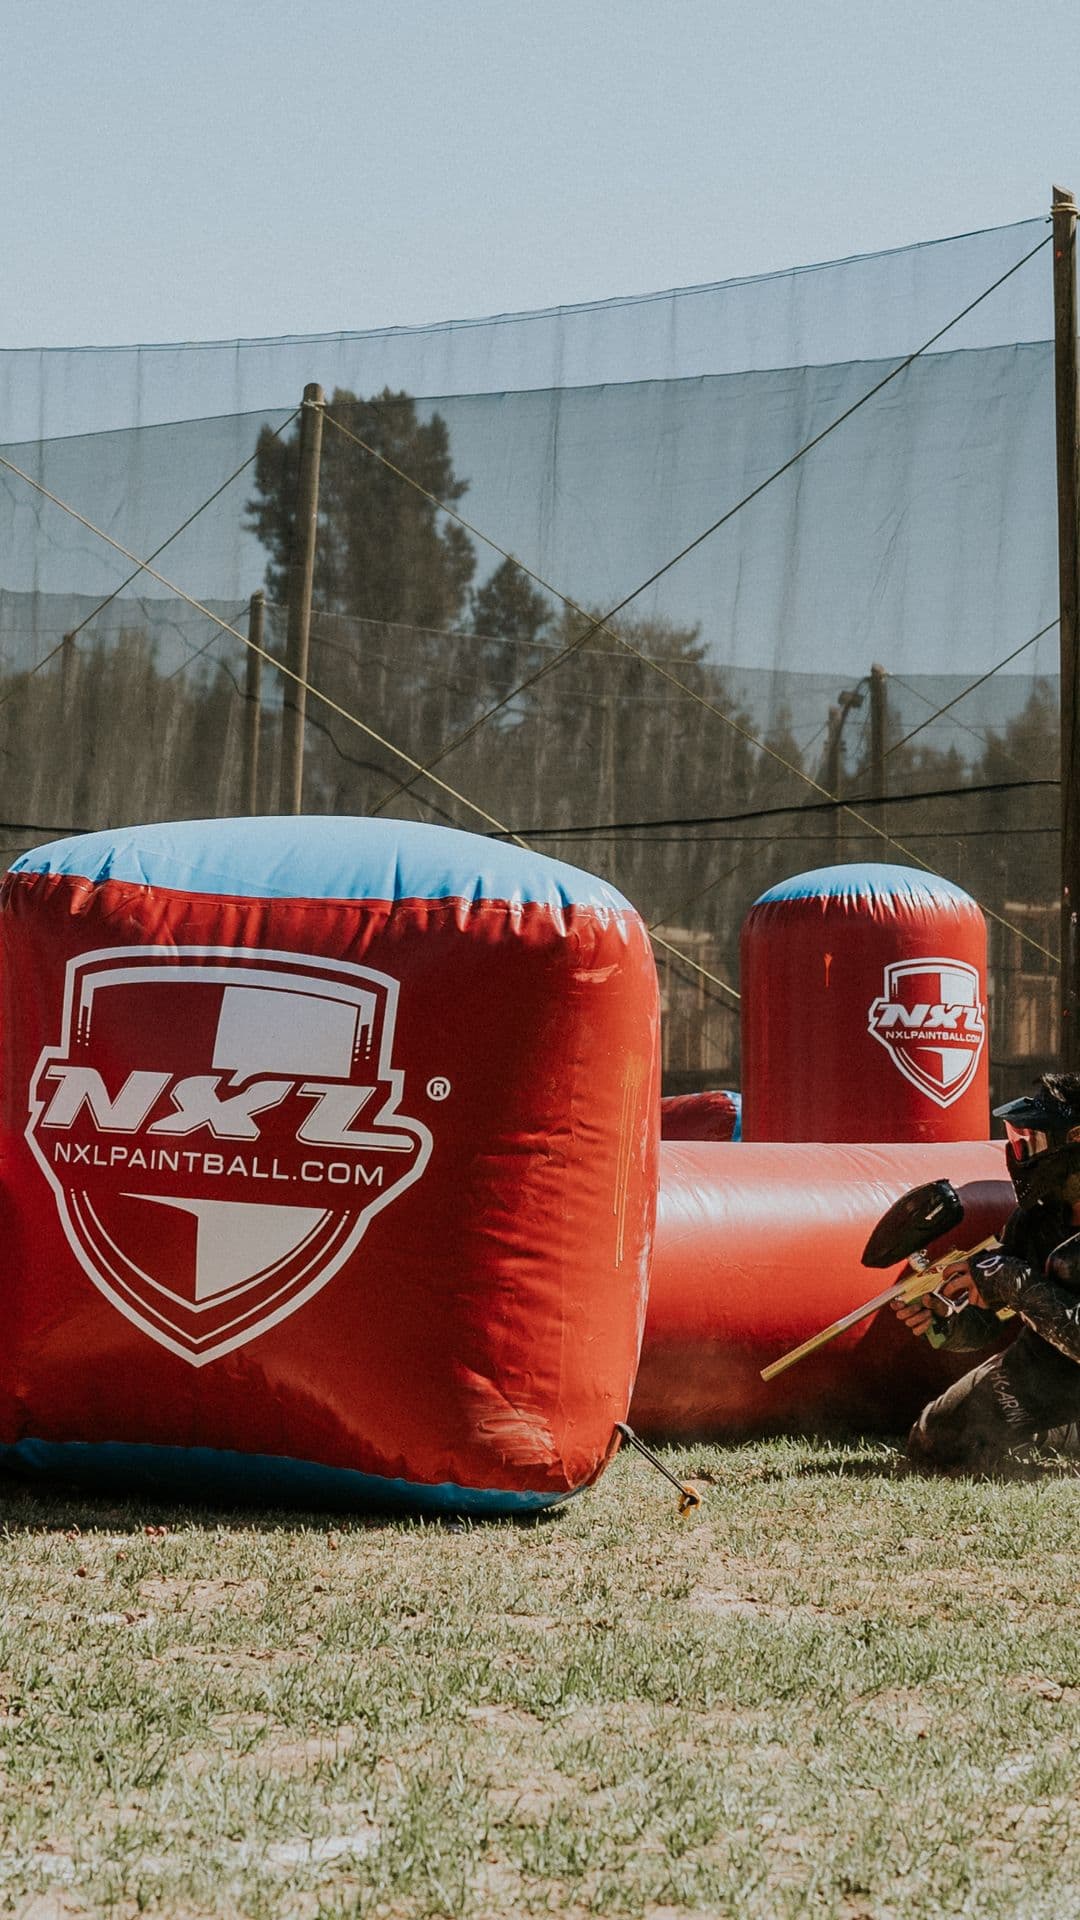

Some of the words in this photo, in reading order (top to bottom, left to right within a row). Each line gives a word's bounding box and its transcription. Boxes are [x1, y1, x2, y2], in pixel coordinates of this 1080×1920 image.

[877, 1004, 983, 1032] NXL
[885, 1030, 981, 1043] NXLPAINTBALL.COM
[40, 1065, 415, 1153] NXL
[54, 1142, 384, 1187] NXLPAINTBALL.COM
